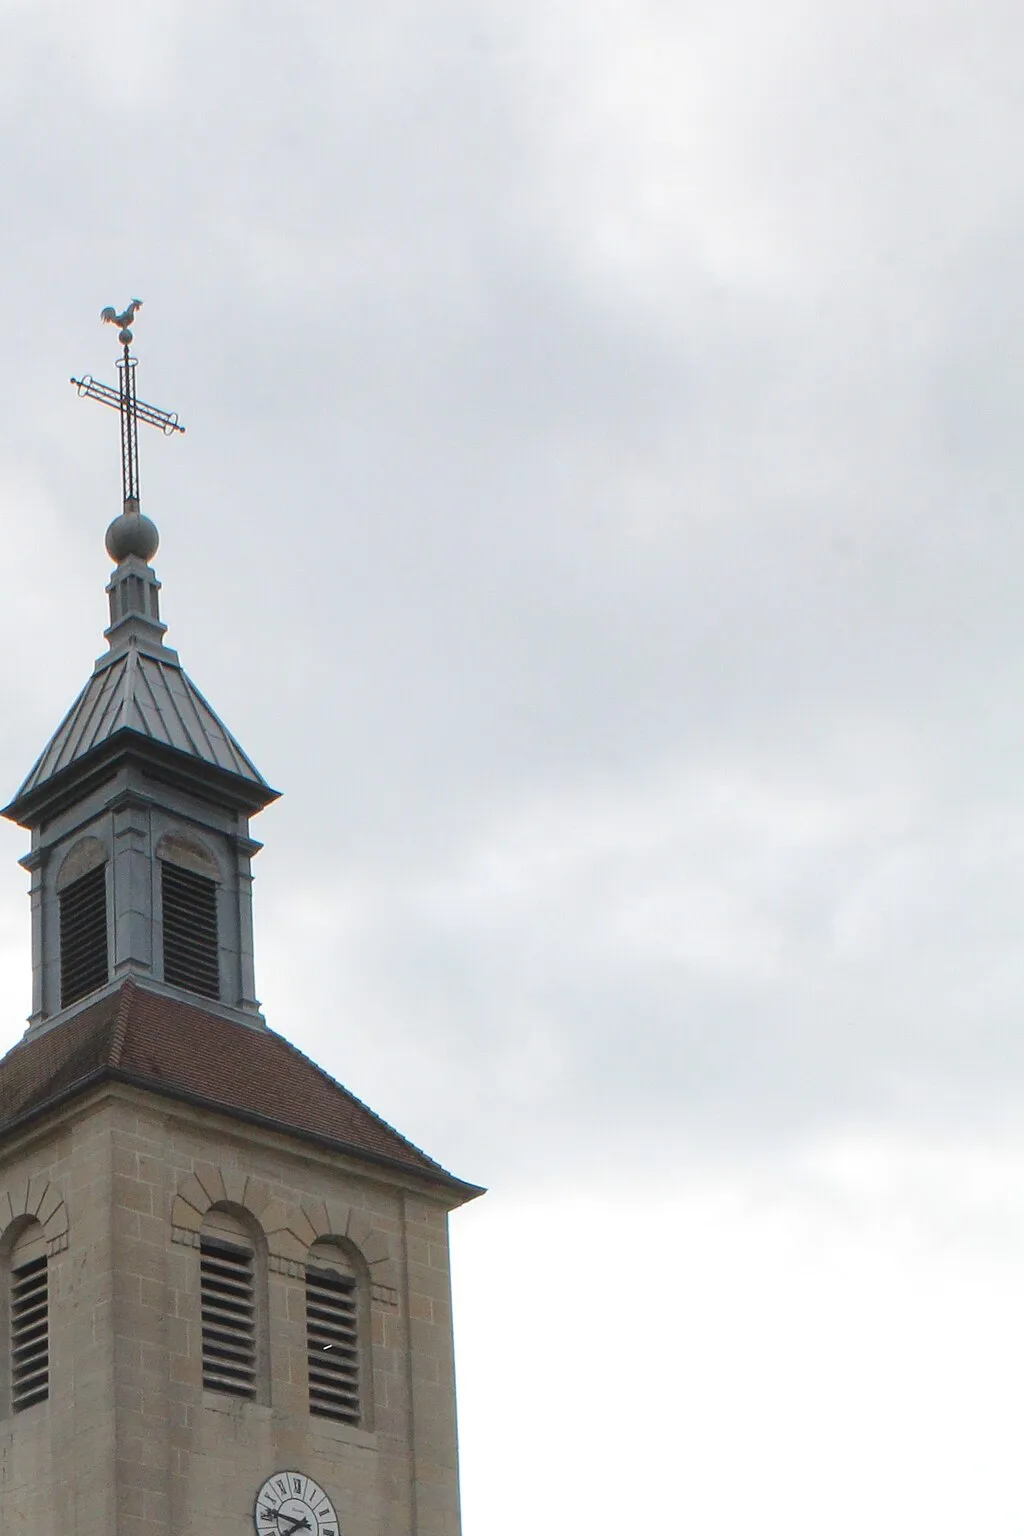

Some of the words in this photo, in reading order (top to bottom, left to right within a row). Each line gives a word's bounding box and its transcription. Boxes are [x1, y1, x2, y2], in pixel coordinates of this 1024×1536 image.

[264, 1492, 277, 1505] X
[309, 1489, 317, 1501] I
[319, 1508, 331, 1517] II
[323, 1528, 335, 1536] III
